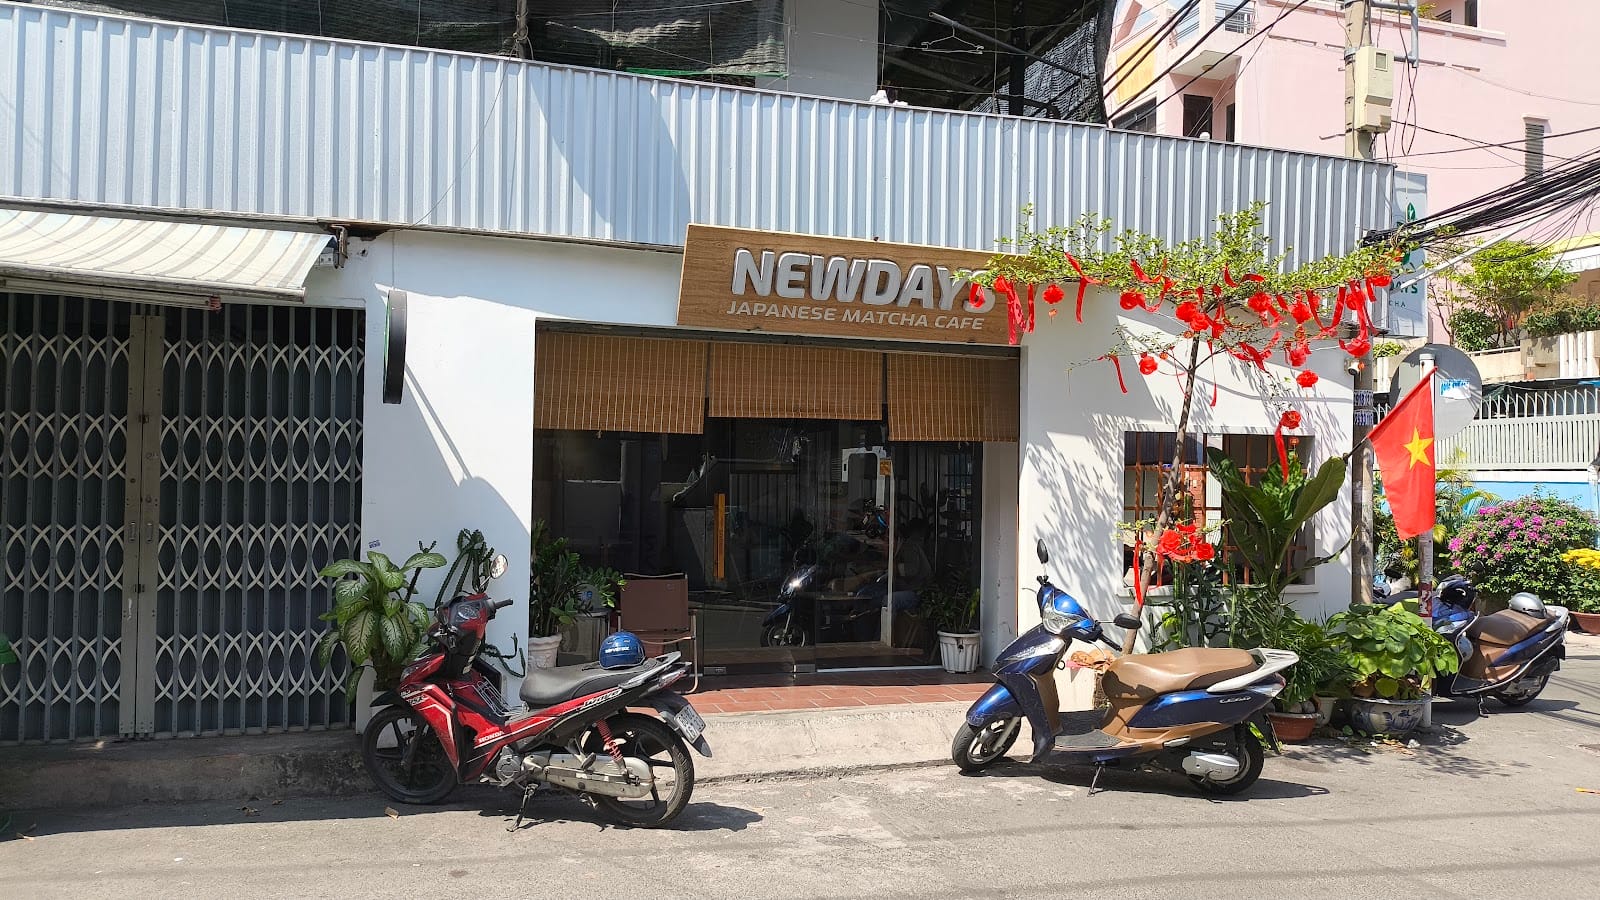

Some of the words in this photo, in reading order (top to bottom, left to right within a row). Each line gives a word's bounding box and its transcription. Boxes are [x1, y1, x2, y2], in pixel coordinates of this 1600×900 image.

[731, 248, 996, 314] NEWDAYS
[726, 300, 836, 322] JAPANESE
[841, 309, 929, 328] MATCHA
[934, 315, 985, 330] CAFE
[478, 730, 505, 743] HONDA
